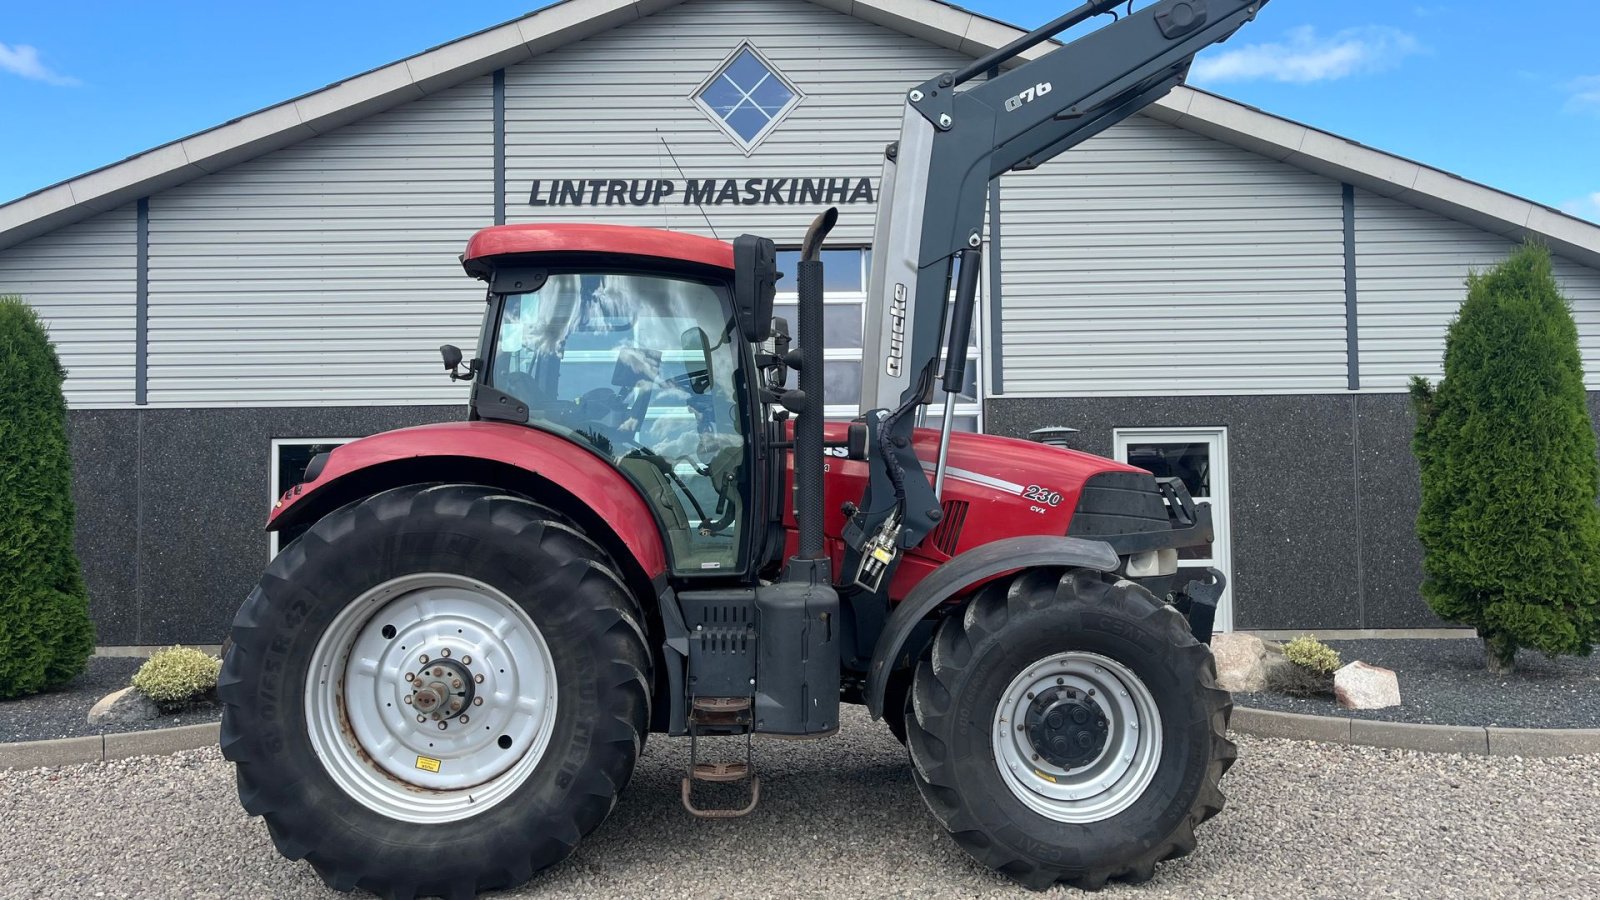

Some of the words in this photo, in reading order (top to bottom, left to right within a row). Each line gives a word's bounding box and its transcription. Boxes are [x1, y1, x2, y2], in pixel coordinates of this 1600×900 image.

[529, 179, 674, 206] LINTRUP
[886, 283, 907, 378] Quicke
[1022, 484, 1064, 507] 230
[1030, 505, 1046, 514] CVX
